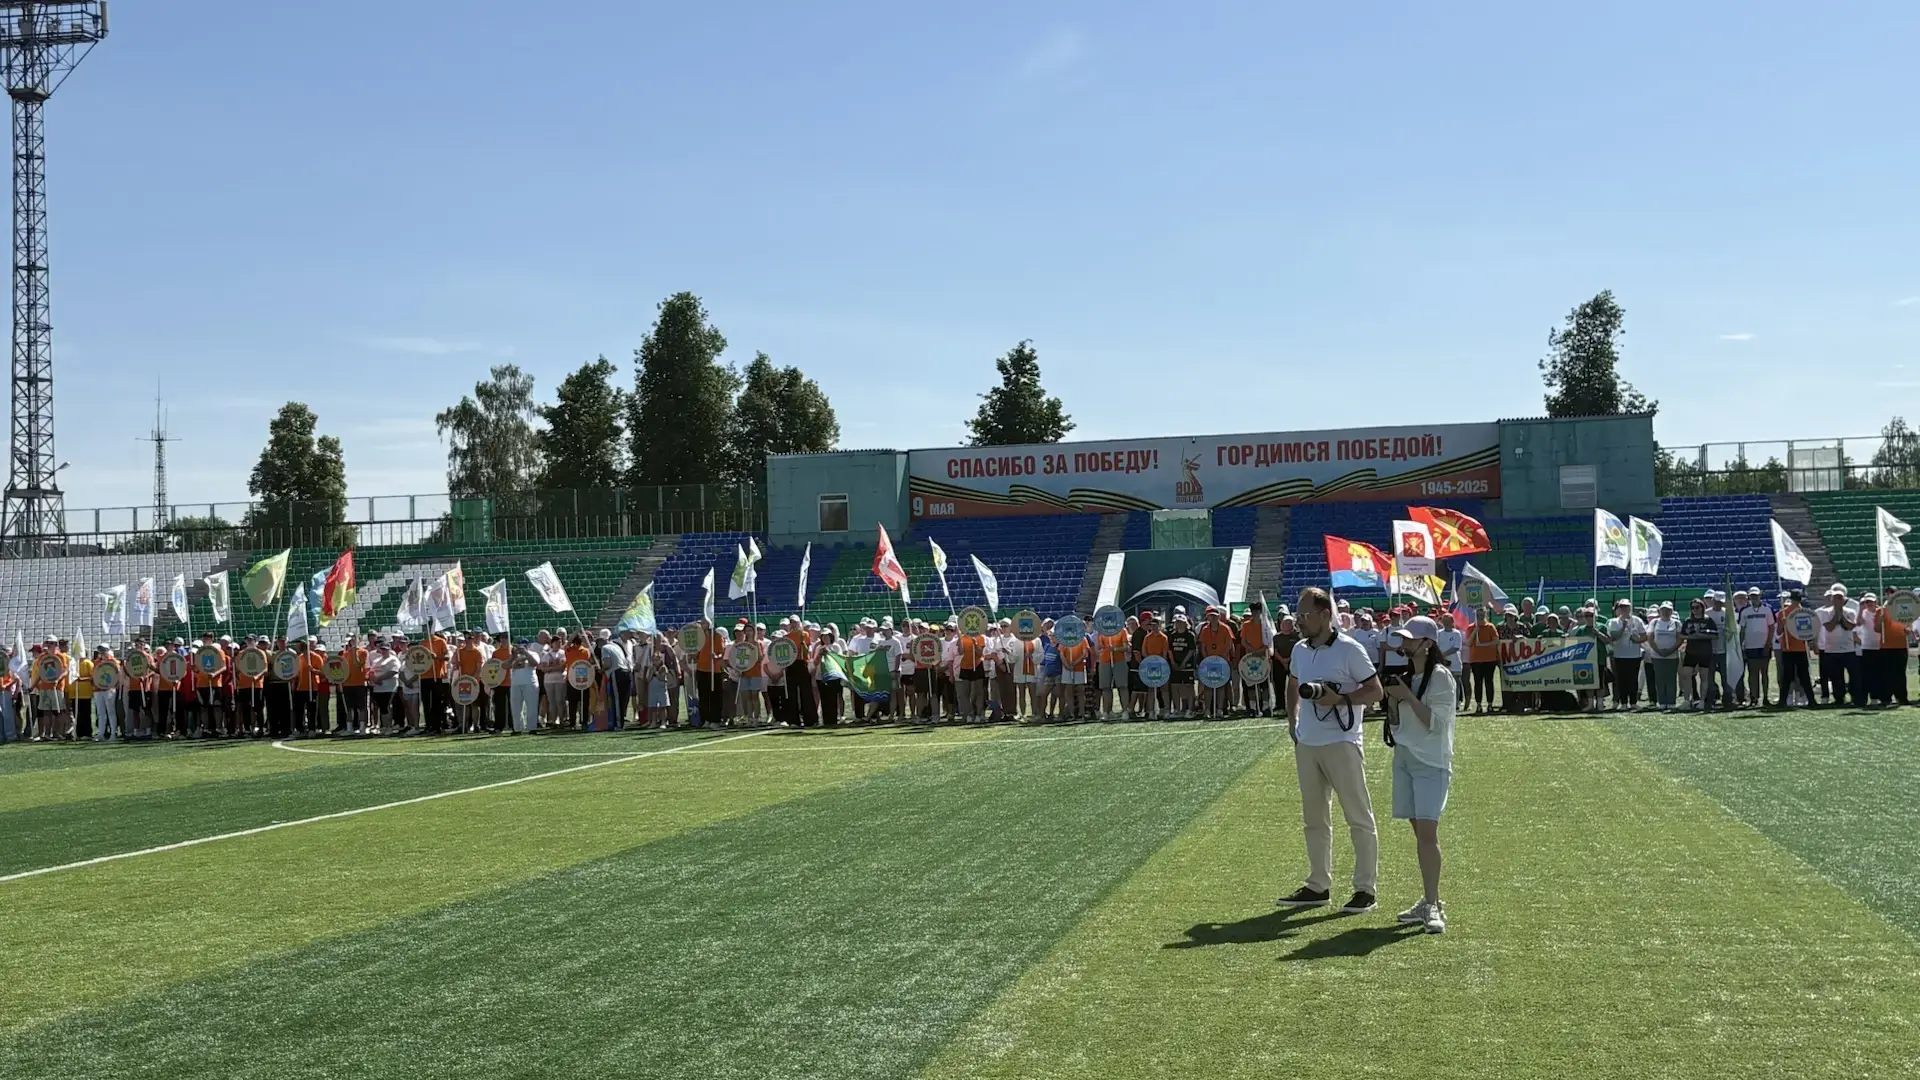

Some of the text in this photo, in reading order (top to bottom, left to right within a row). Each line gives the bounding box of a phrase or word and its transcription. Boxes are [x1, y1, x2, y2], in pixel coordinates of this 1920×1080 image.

[1216, 433, 1443, 468] ГОРДИМСЯ ПОБЕДОЙ!
[947, 449, 1159, 479] СПАСИБО ЗА ПОБЕДУ!
[1419, 480, 1489, 496] 1945-2025
[912, 496, 955, 517] 9 МАЯ
[1534, 643, 1588, 667] команда!
